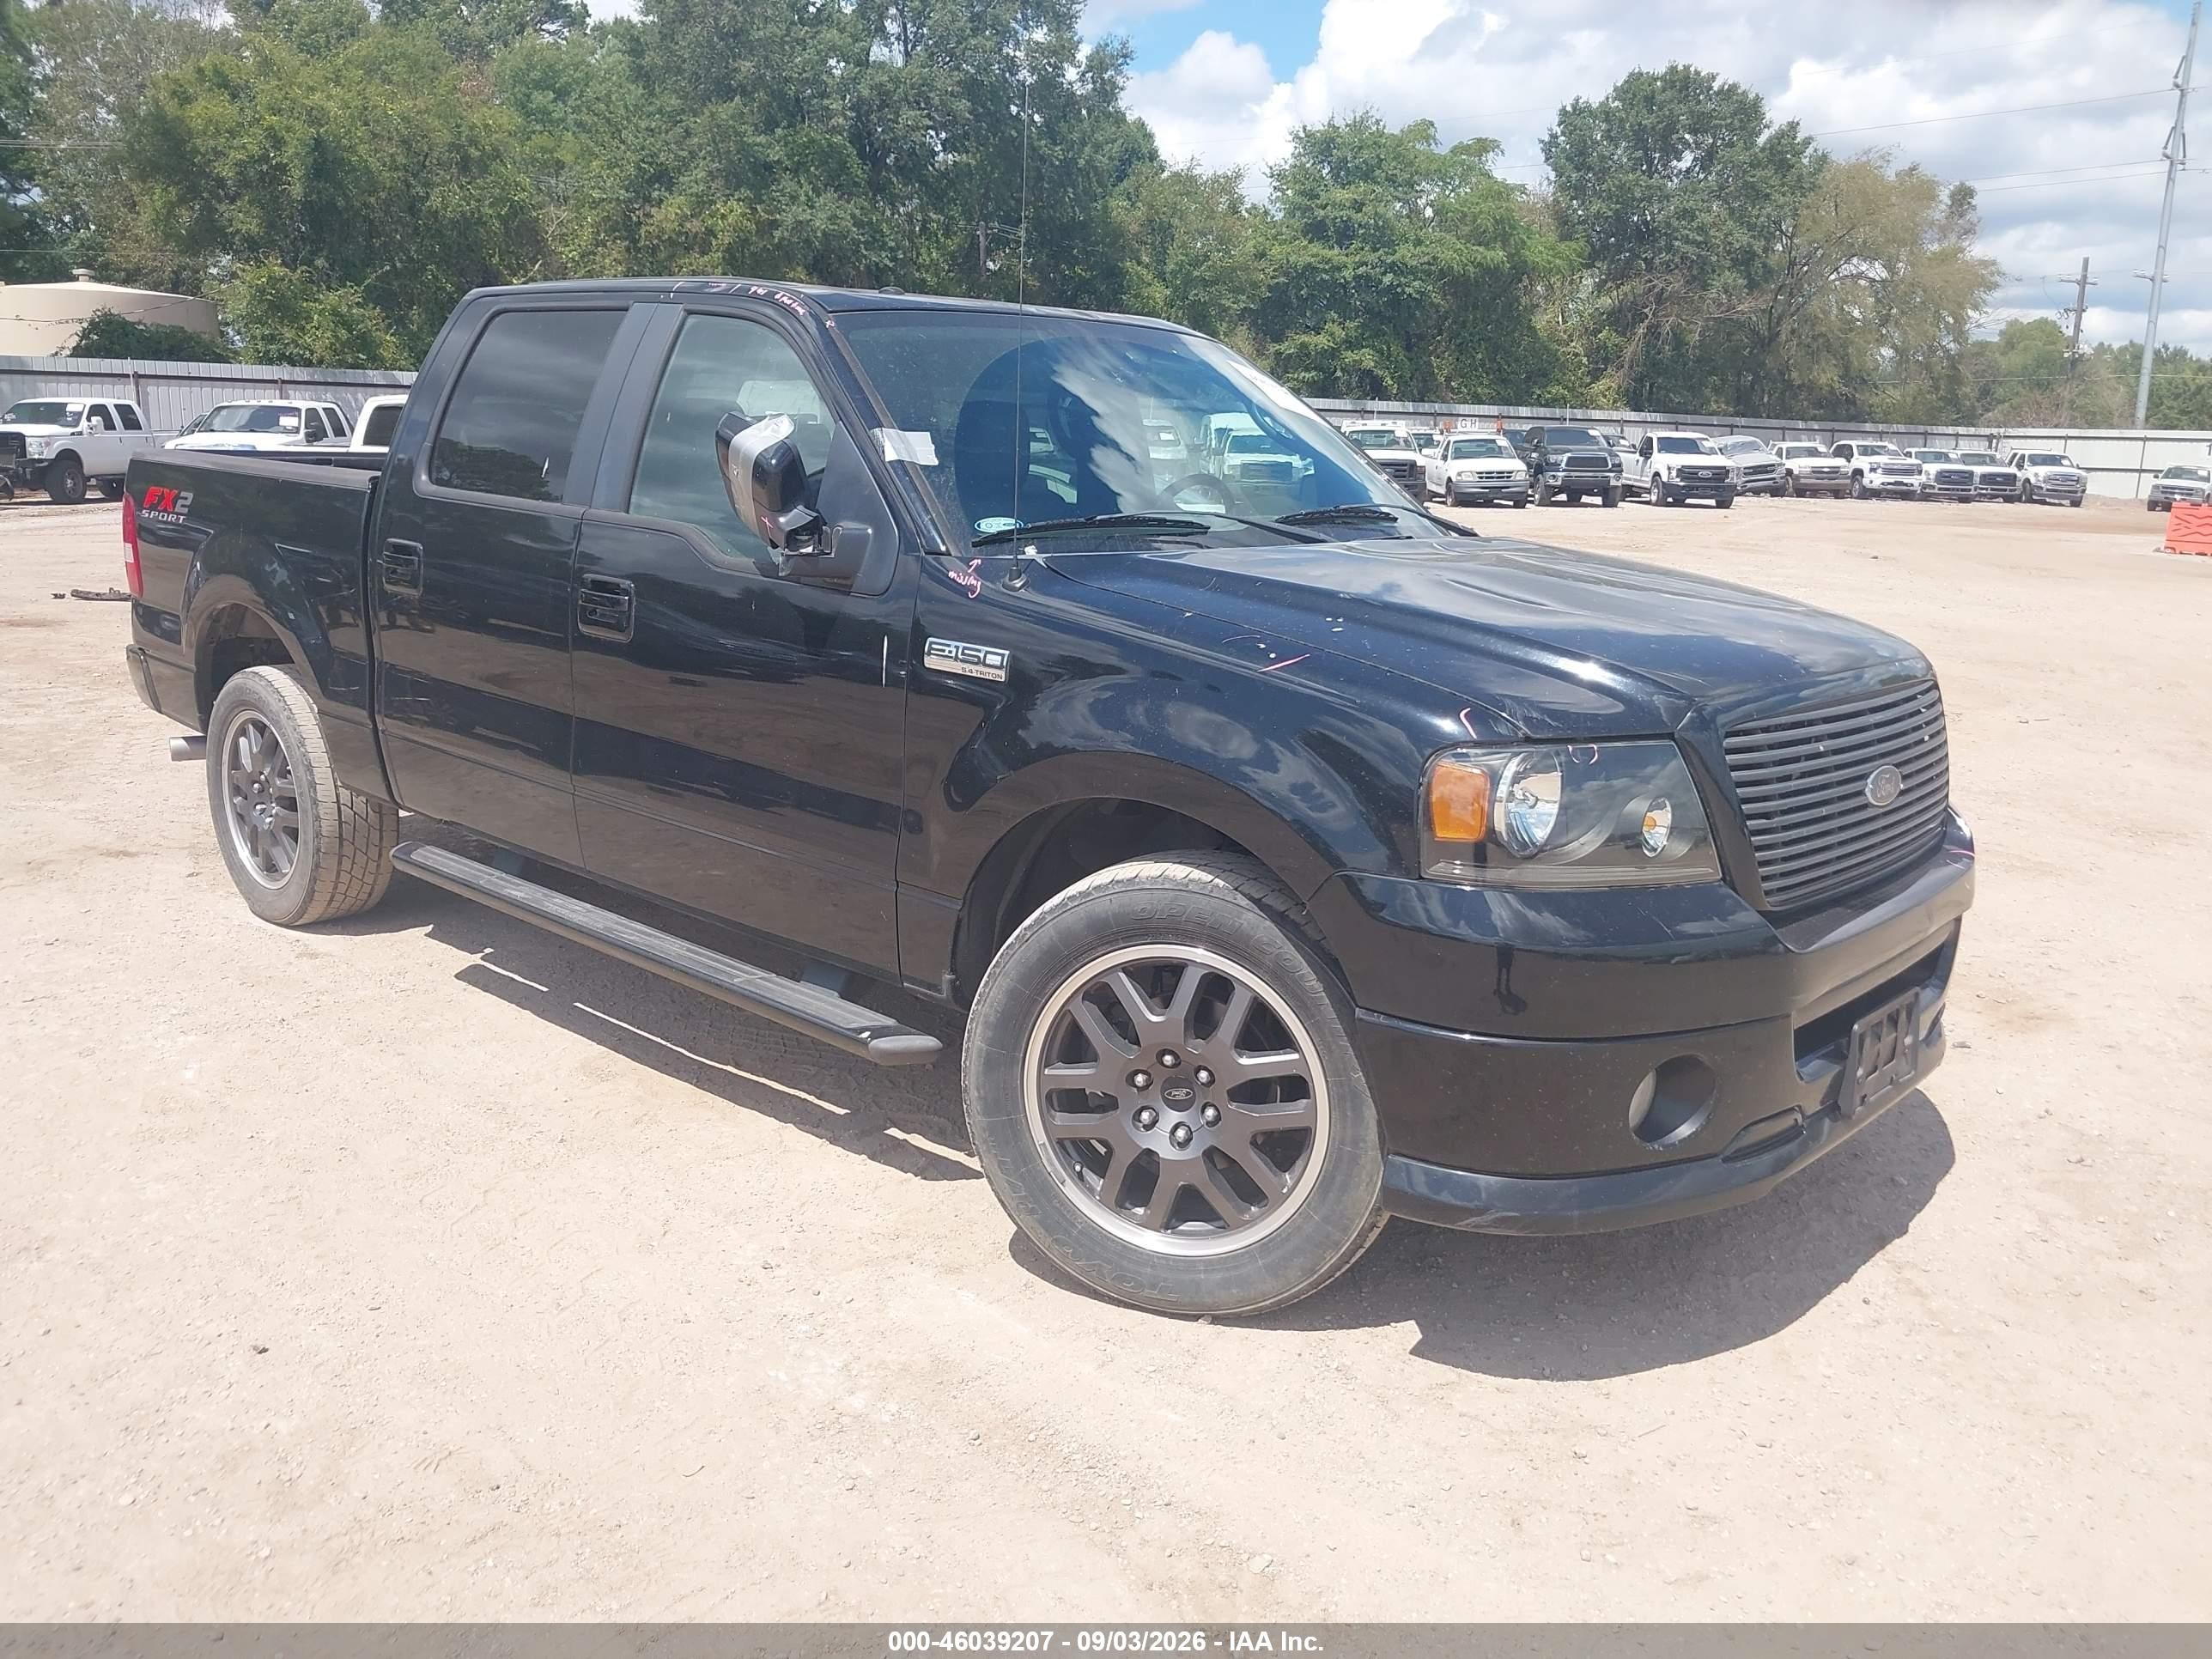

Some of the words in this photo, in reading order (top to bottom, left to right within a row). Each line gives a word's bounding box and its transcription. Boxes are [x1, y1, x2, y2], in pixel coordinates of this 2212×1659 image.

[143, 486, 193, 514] FX2
[141, 509, 185, 524] SPORT
[975, 669, 1003, 679] TRITON
[1132, 902, 1244, 935] OPEN
[1249, 933, 1372, 1100] COUY
[1050, 1235, 1182, 1303] TOYO
